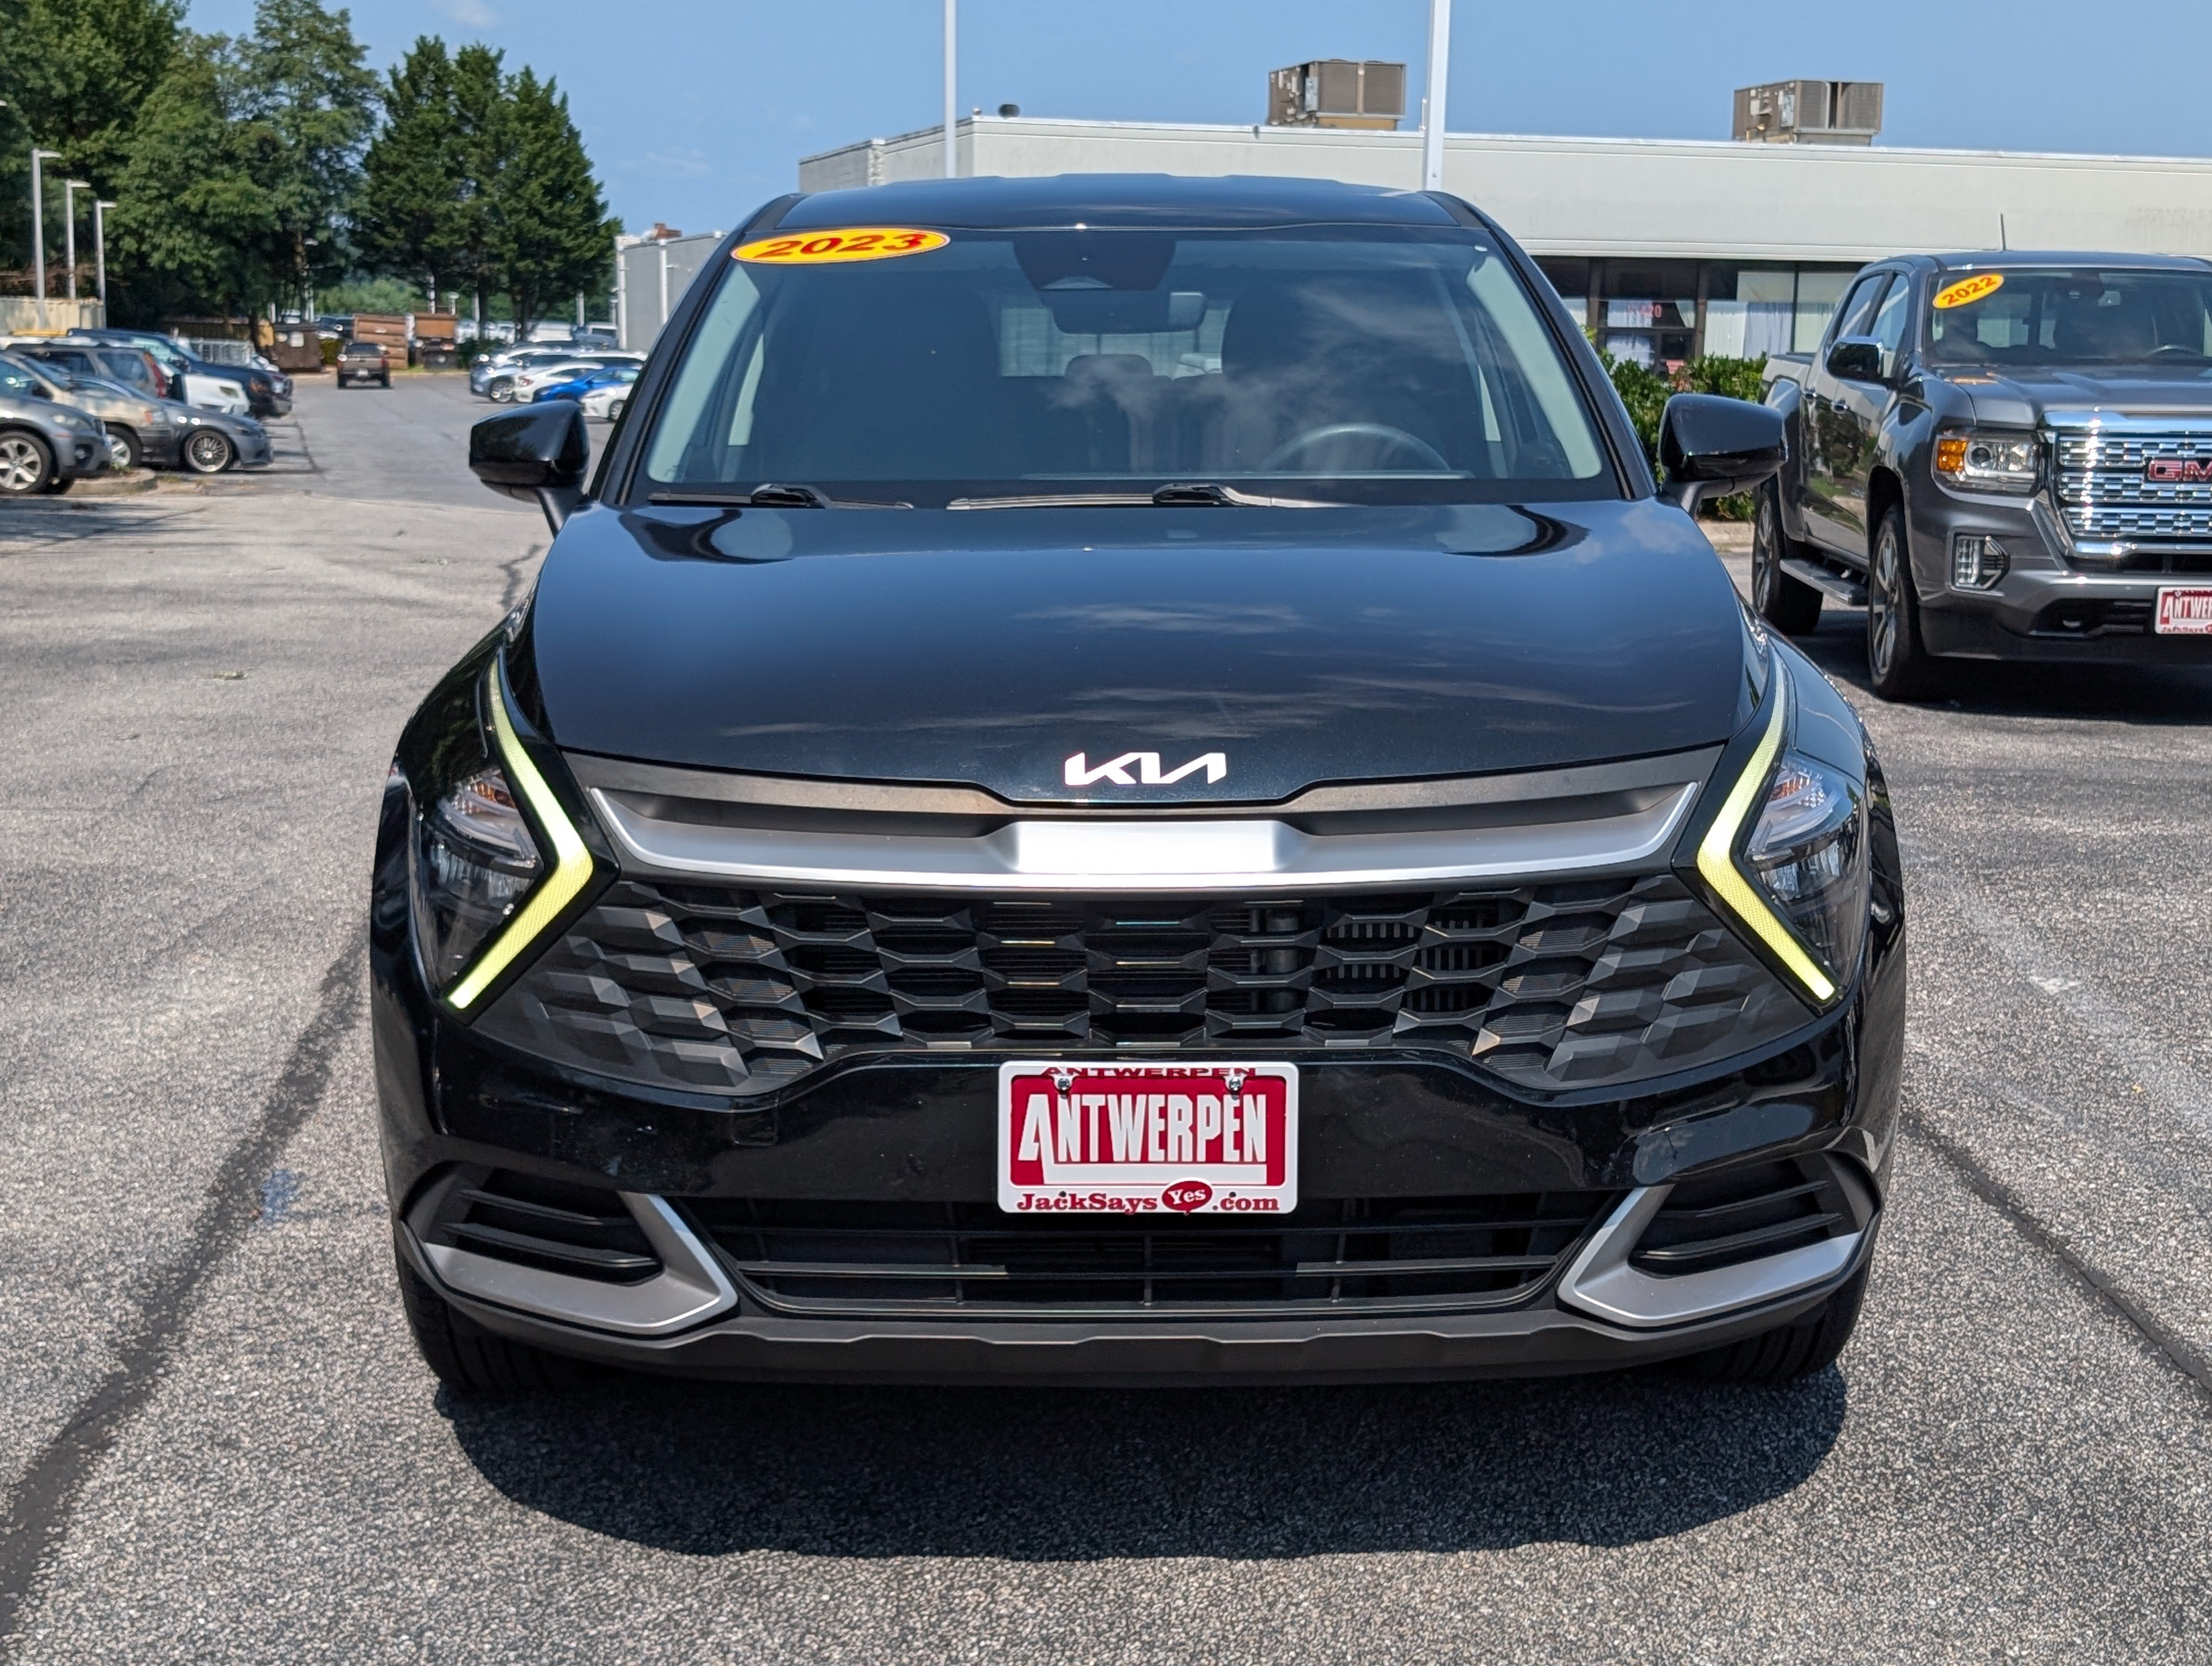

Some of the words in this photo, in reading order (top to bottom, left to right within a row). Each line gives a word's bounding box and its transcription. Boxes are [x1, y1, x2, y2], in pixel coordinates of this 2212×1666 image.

[753, 233, 928, 259] 2023
[1941, 276, 1997, 306] 2022
[1064, 752, 1227, 786] KIA
[1041, 1066, 1256, 1077] ANTWERPEN
[1017, 1094, 1267, 1163] ANTWERPEN
